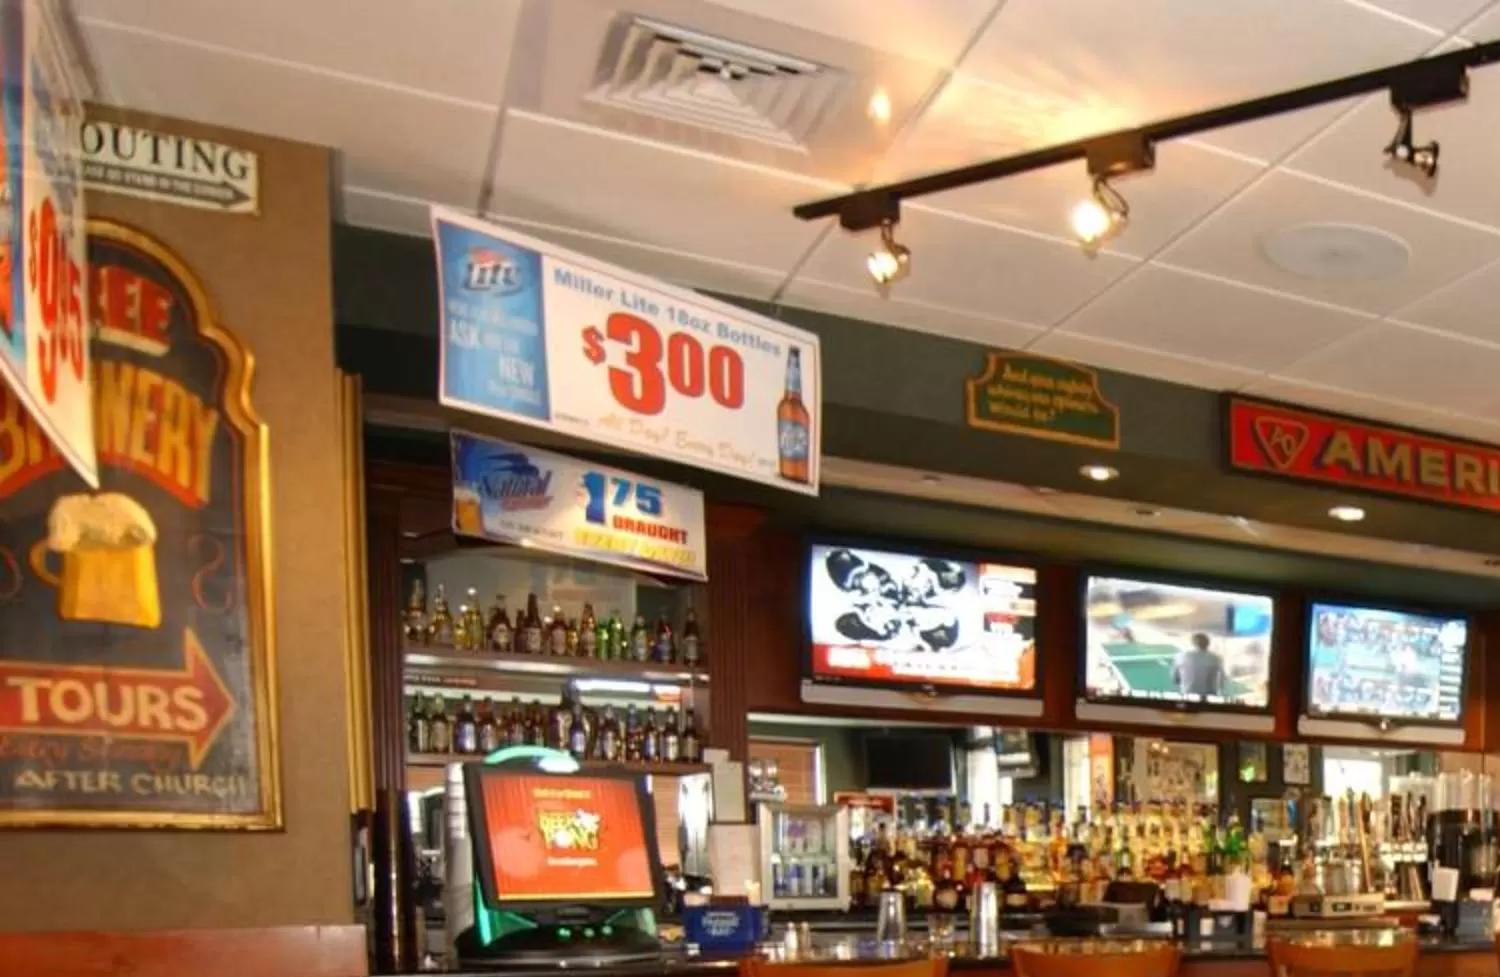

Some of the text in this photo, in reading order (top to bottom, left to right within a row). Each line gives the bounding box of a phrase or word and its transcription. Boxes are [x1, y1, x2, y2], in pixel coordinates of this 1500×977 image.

[553, 268, 615, 301] Miller
[620, 291, 660, 317] Lite
[717, 322, 783, 358] Bottles
[6, 676, 209, 732] TOURS
[14, 769, 246, 798] AFTER CHURCH
